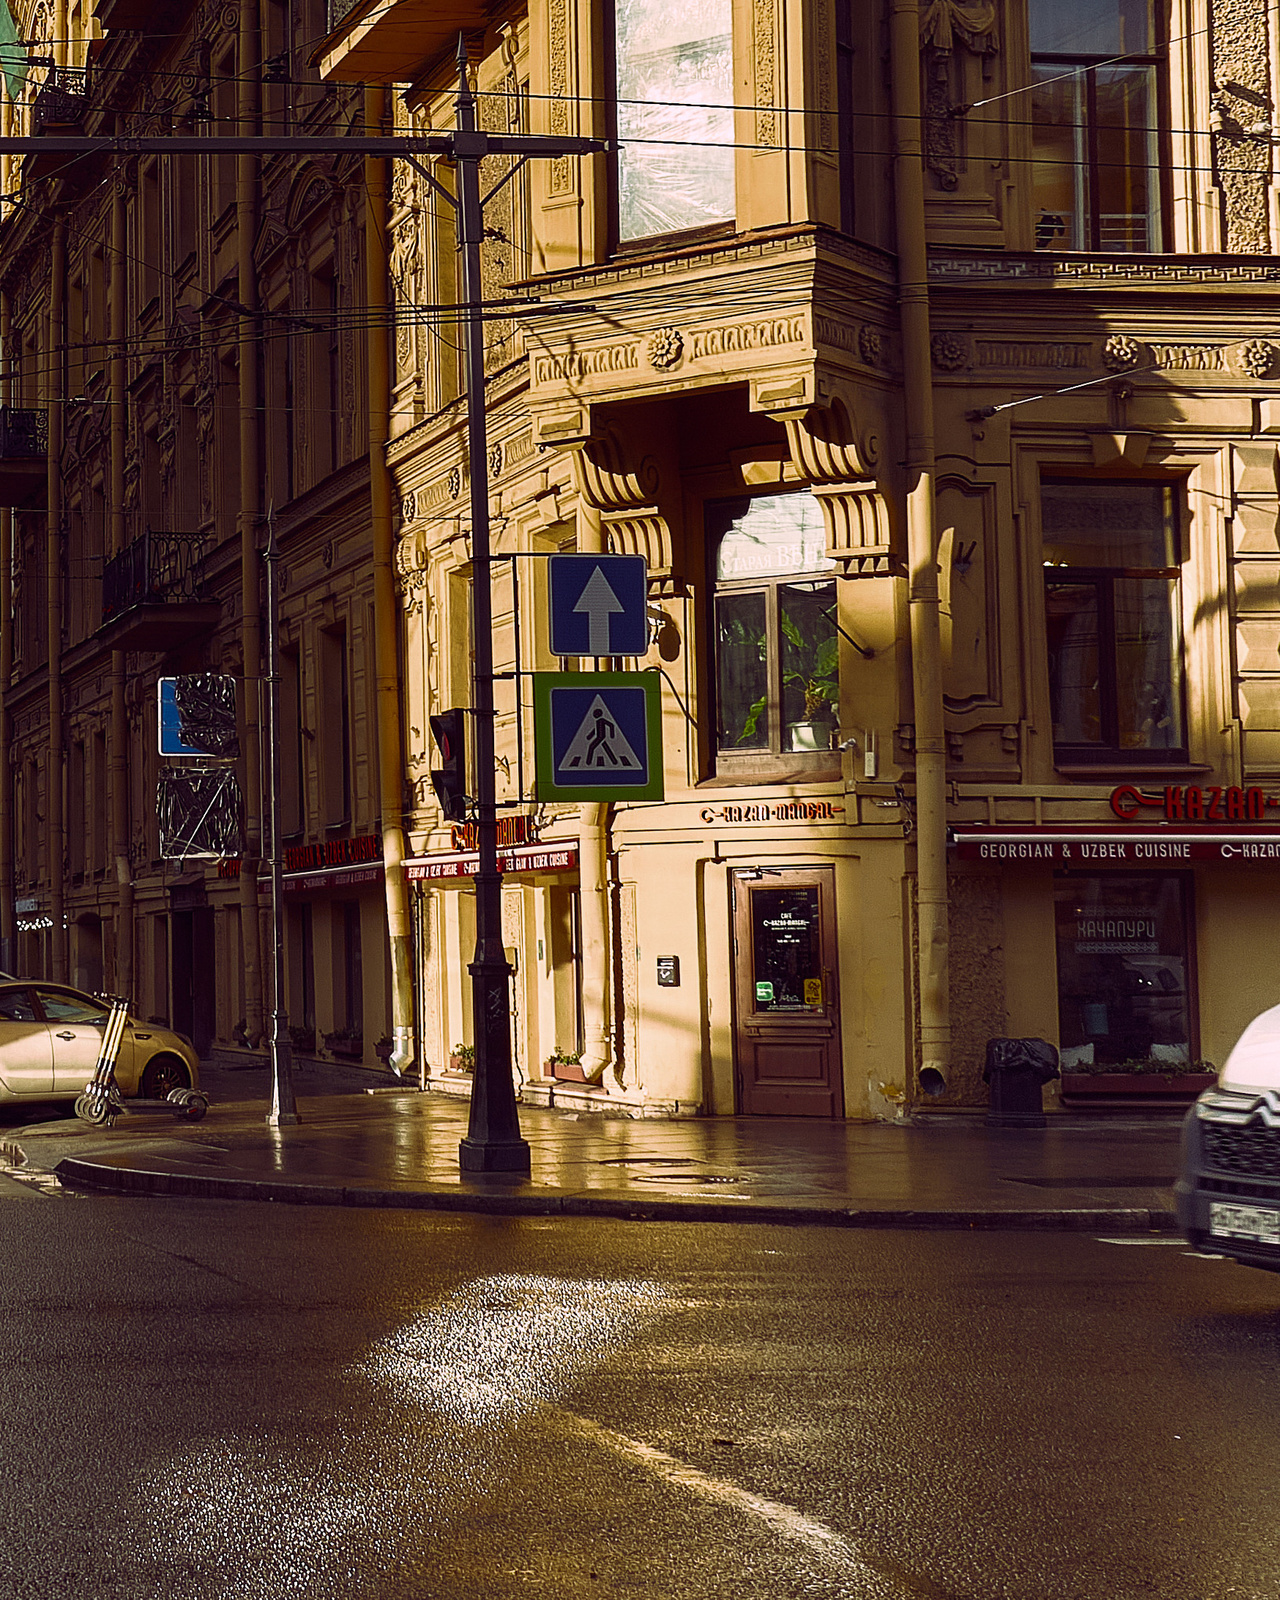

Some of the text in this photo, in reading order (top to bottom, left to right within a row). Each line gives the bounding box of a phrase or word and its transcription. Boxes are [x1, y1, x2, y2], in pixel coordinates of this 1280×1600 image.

[980, 843, 1191, 858] GEORGIAN & UZBEK CUISINE
